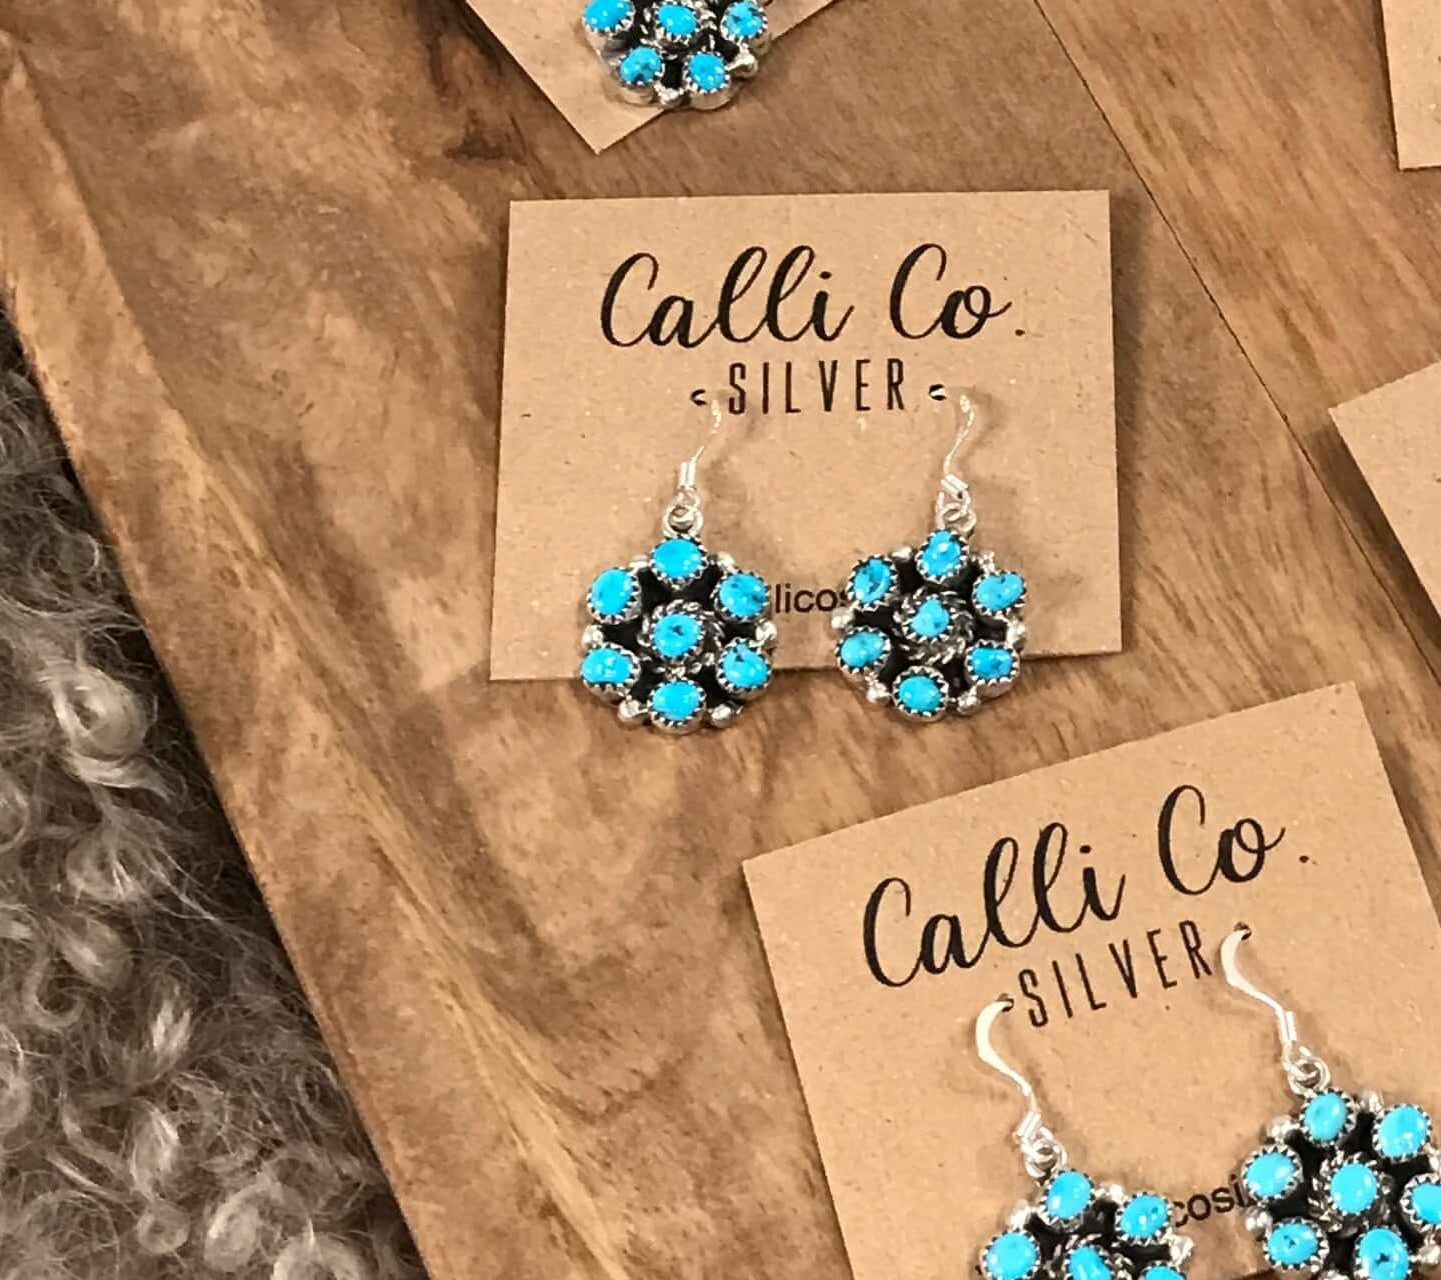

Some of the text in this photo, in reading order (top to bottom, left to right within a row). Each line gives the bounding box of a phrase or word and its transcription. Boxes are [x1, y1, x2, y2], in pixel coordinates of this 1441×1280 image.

[600, 243, 1025, 348] Calli Co.
[728, 358, 905, 415] SILVER
[863, 785, 1310, 988] Calli Co.
[1018, 921, 1212, 1028] SILVER
